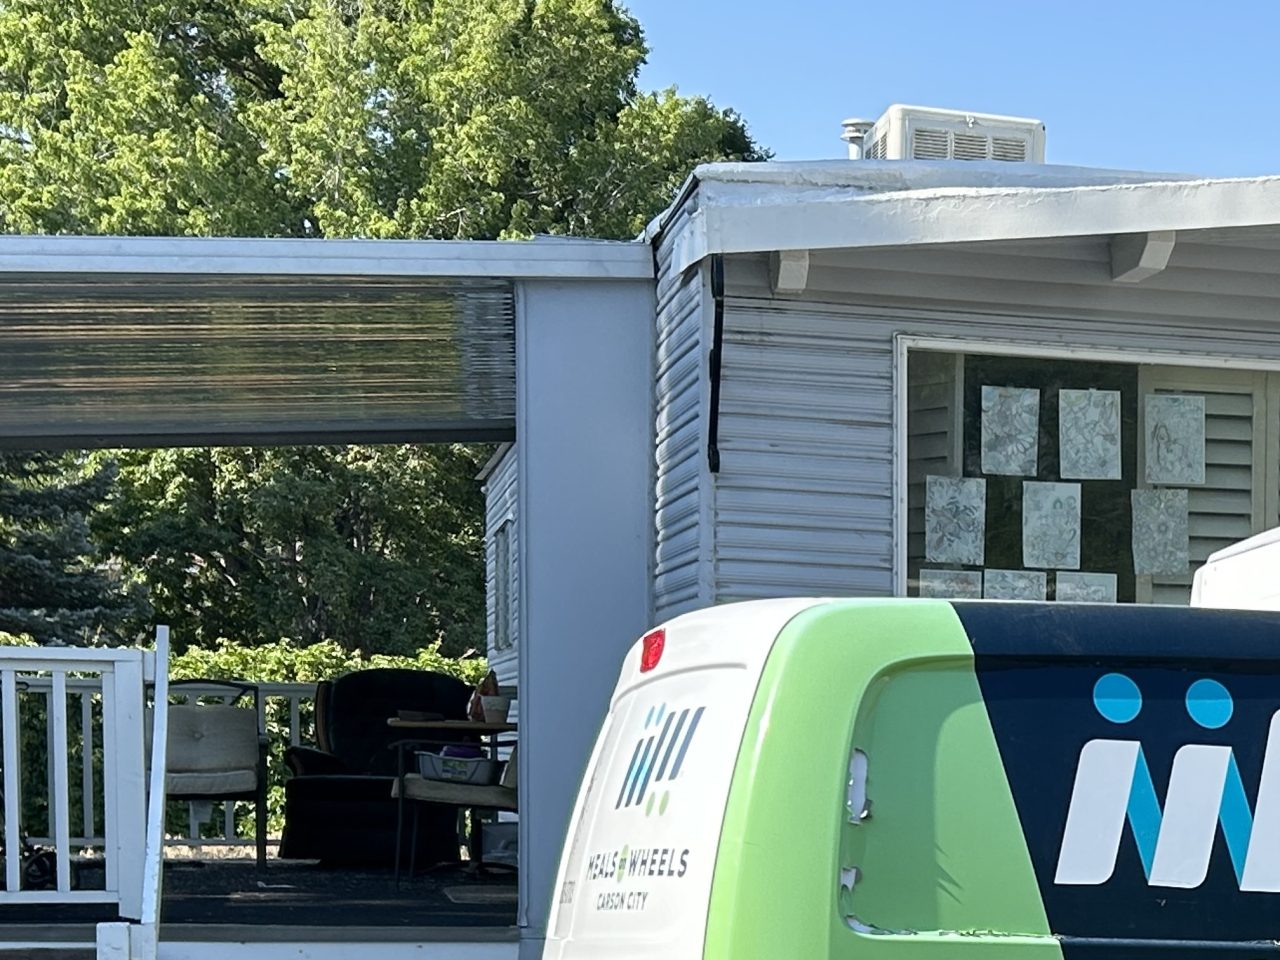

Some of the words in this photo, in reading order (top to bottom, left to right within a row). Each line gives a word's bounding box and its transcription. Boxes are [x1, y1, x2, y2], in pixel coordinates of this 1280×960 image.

[586, 850, 619, 881] MEALS
[627, 847, 690, 878] WHEELS
[596, 891, 626, 911] CARSON
[626, 891, 649, 911] CITY
